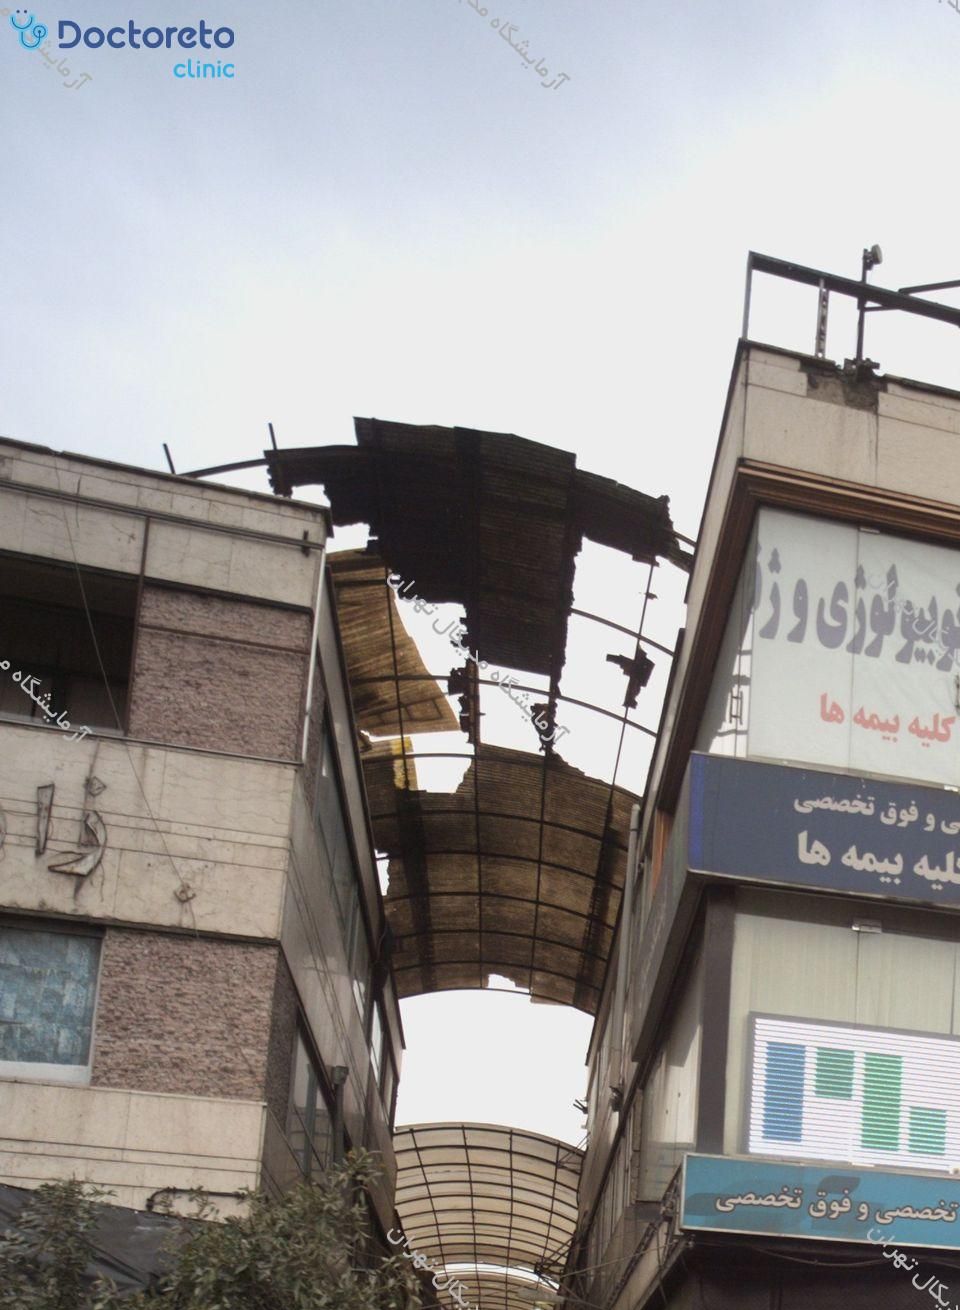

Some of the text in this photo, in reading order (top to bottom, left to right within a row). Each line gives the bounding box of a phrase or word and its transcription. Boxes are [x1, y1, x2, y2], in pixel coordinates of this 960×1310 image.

[820, 691, 847, 725] ها
[852, 704, 902, 744] بیمه
[906, 711, 956, 747] کلیه
[793, 794, 876, 817] تخصصی
[880, 799, 920, 828] فوق
[923, 812, 936, 832] و
[797, 829, 832, 867] ها
[840, 844, 904, 886] بیمه
[715, 1186, 802, 1213] تخصصی
[808, 1195, 852, 1219] فوق
[858, 1203, 869, 1221] و
[875, 1200, 957, 1225] تخصصی
